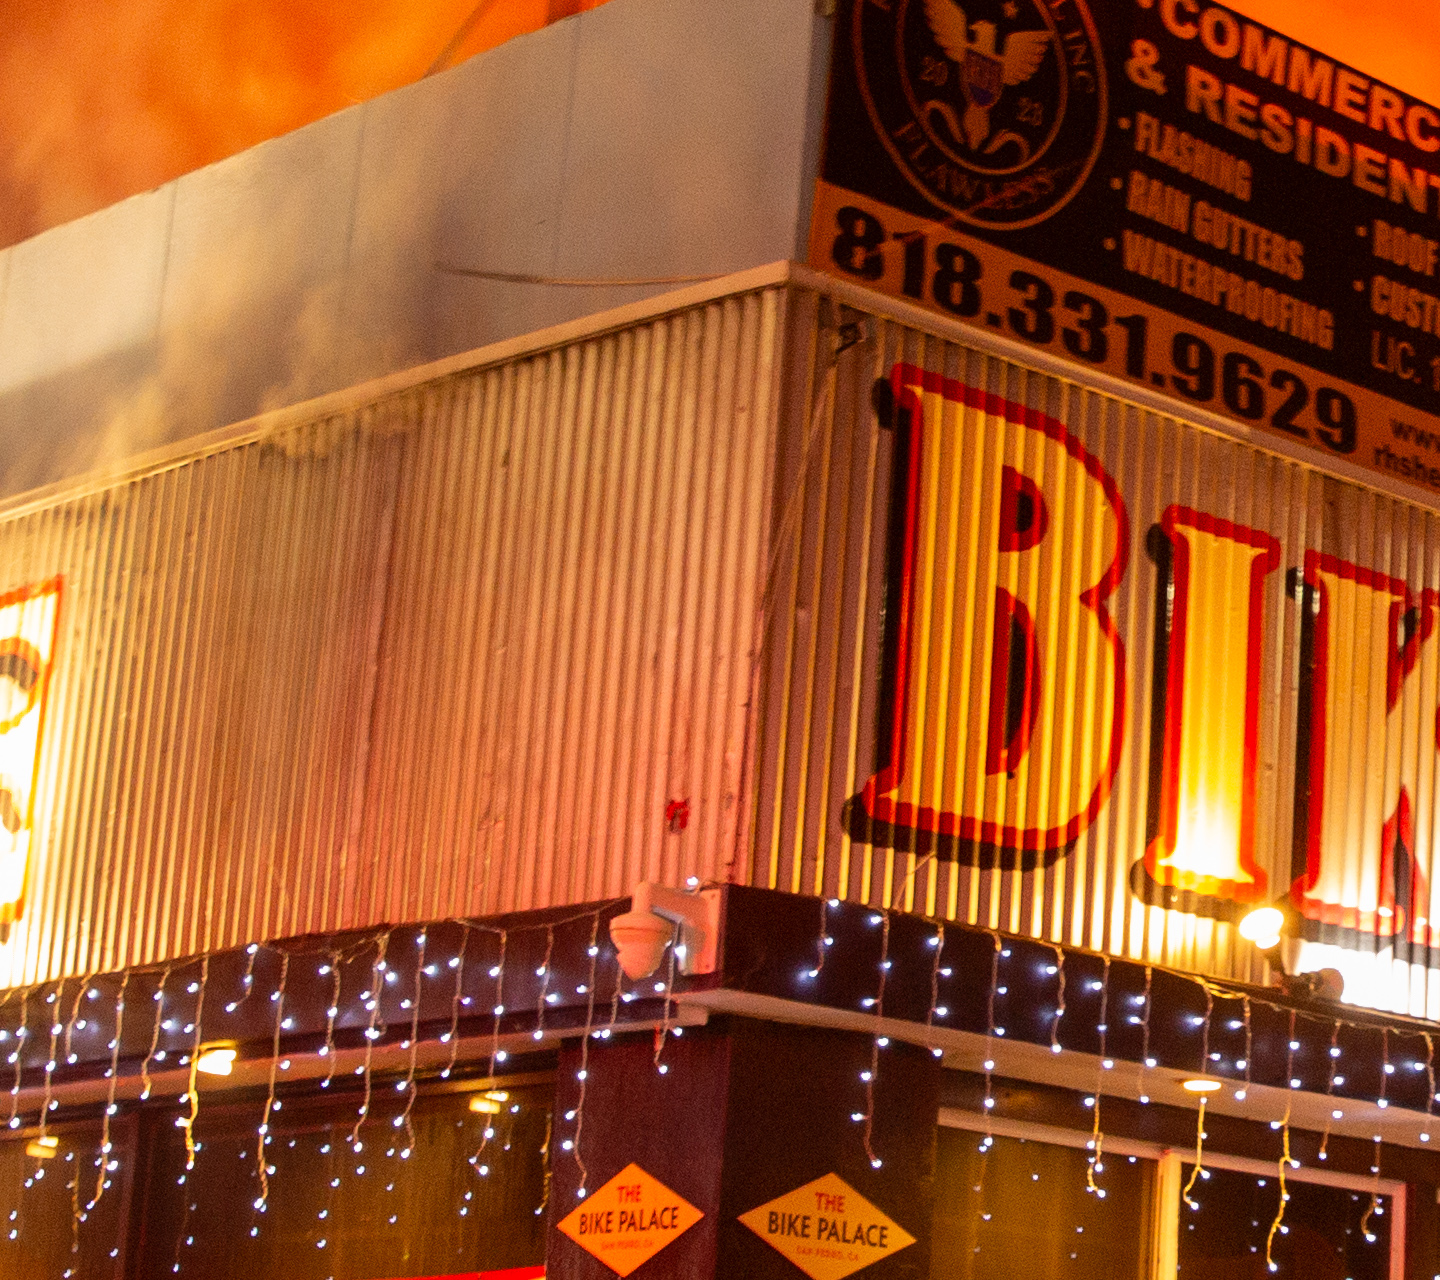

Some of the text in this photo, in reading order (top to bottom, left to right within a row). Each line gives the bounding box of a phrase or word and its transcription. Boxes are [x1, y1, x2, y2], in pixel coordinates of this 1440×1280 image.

[1064, 29, 1096, 94] INC
[1125, 38, 1168, 96] &
[1134, 111, 1252, 203] FLASHING
[1126, 170, 1305, 281] RAIN GUTTERS
[1372, 219, 1439, 277] ROOF
[1122, 229, 1335, 351] WATERPROOFING
[832, 205, 1358, 456] 818.331.9629
[1370, 329, 1422, 384] LIC.
[579, 1206, 679, 1235] BIKE PALACE
[617, 1185, 642, 1204] THE
[815, 1192, 846, 1213] THE
[767, 1211, 889, 1248] BIKE PALACE
